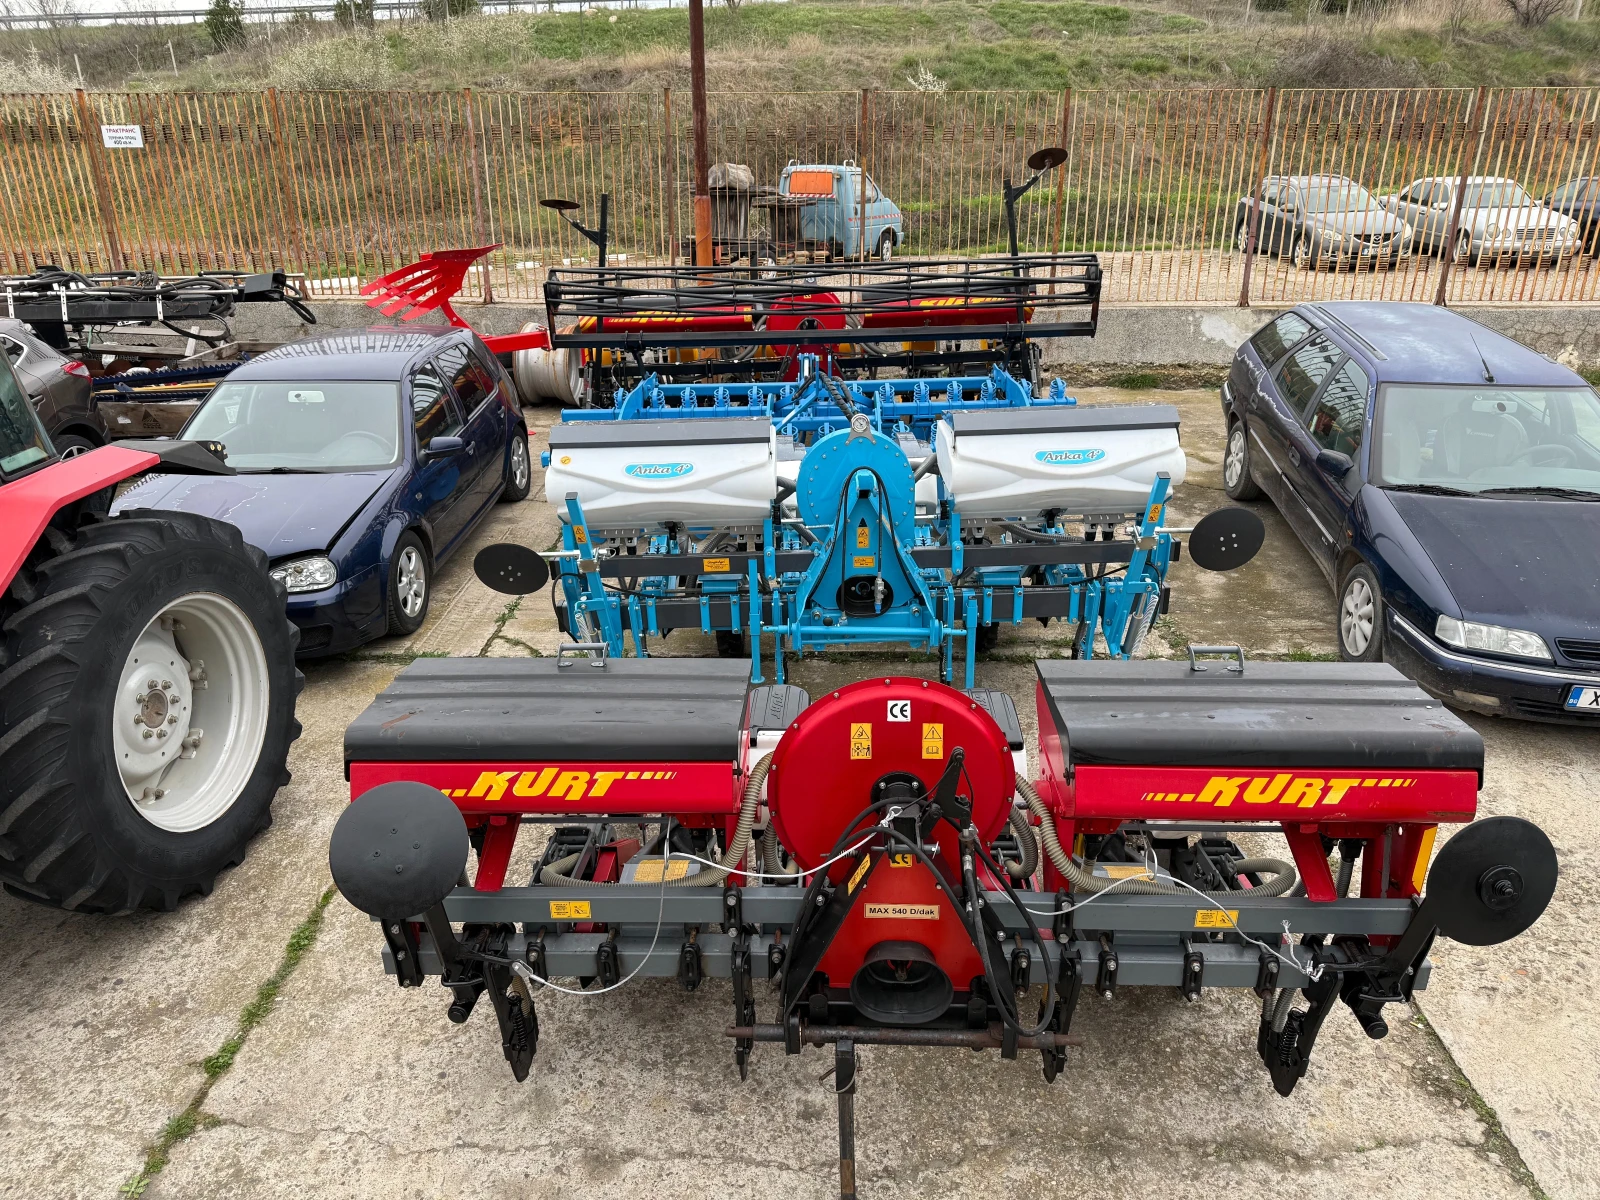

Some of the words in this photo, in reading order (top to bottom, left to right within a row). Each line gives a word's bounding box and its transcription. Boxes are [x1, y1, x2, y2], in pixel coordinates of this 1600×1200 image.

[1043, 451, 1084, 461] Anka
[631, 464, 672, 475] Anka
[889, 702, 909, 719] CE
[467, 768, 625, 800] KURT
[1195, 774, 1362, 808] KURT
[869, 907, 890, 915] MAX
[909, 908, 935, 916] D/dak
